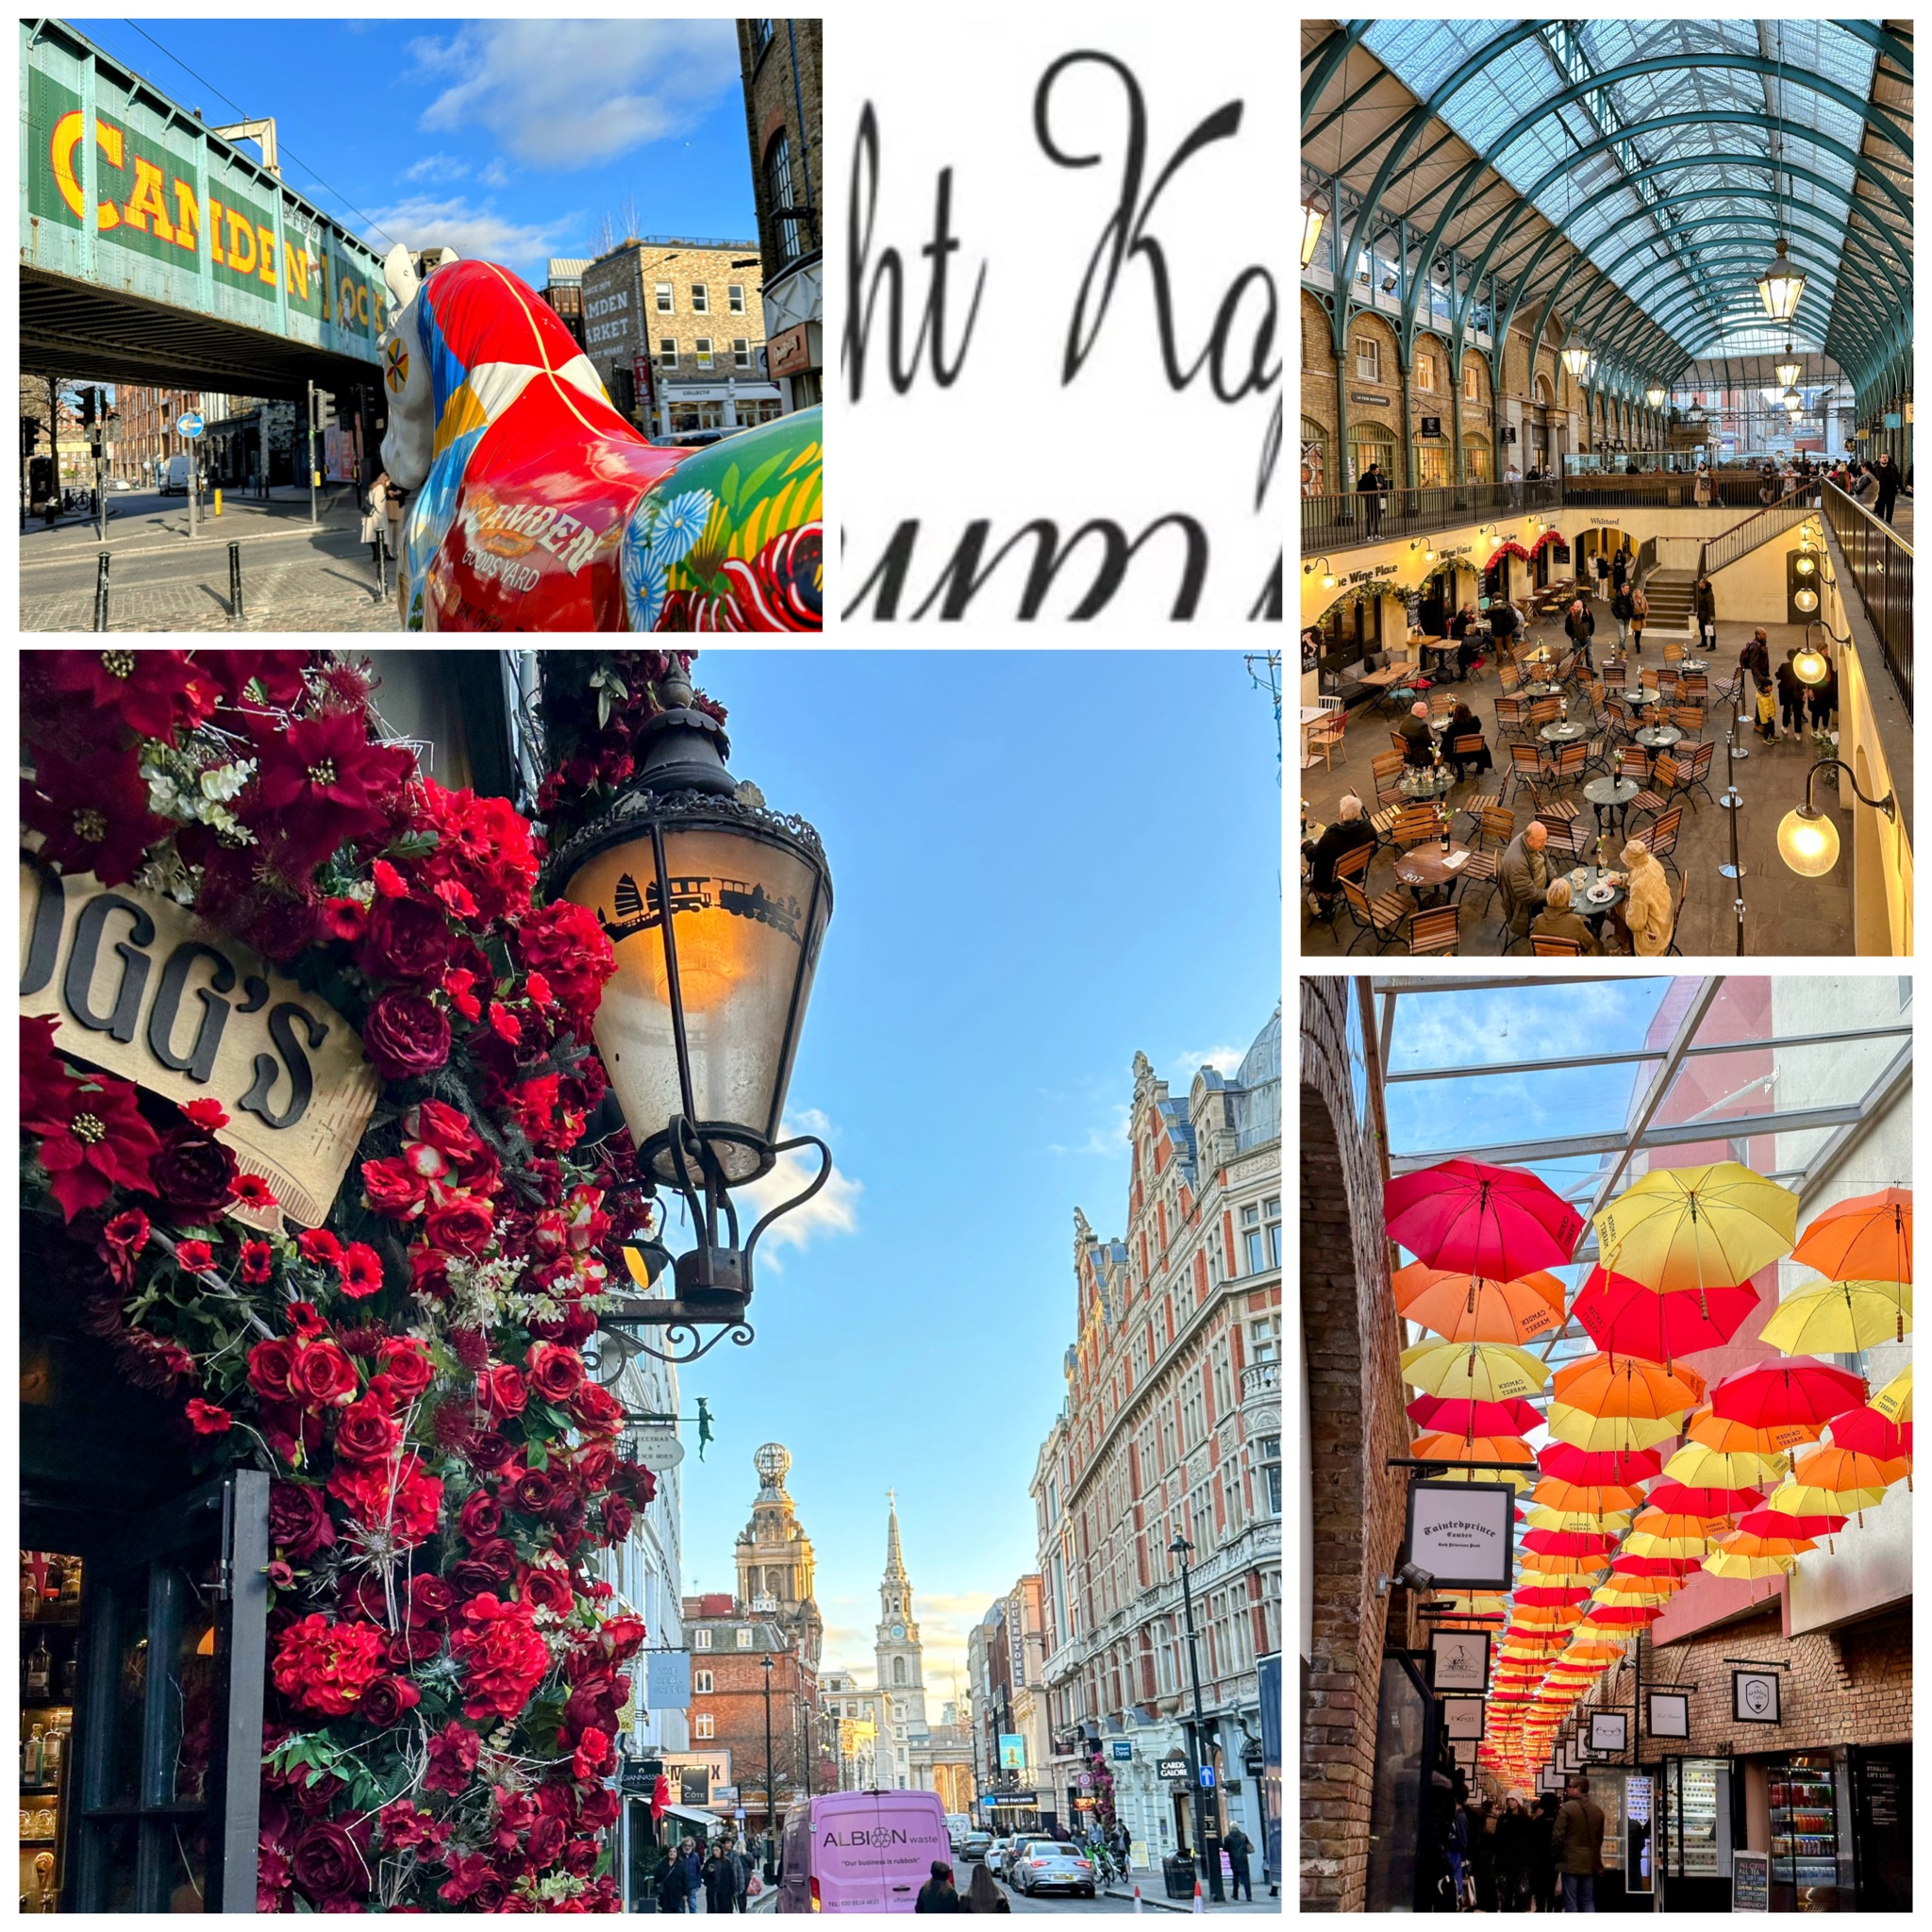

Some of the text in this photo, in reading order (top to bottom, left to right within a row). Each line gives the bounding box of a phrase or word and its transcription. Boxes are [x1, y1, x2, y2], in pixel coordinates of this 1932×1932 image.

[50, 109, 308, 301] CAMDEN
[463, 504, 605, 578] CAMDEN
[1441, 549, 1457, 559] Wine
[461, 548, 541, 592] GOODS YARD
[1349, 570, 1374, 583] Wine
[1375, 564, 1398, 577] Place
[1403, 873, 1424, 883] 207
[1424, 1521, 1496, 1538] Taintedprince
[1011, 1601, 1020, 1634] DUKE
[658, 1667, 677, 1675] THE
[1014, 1643, 1023, 1686] YORK'S
[653, 1686, 686, 1694] GREEK
[1160, 1769, 1189, 1777] GALORE
